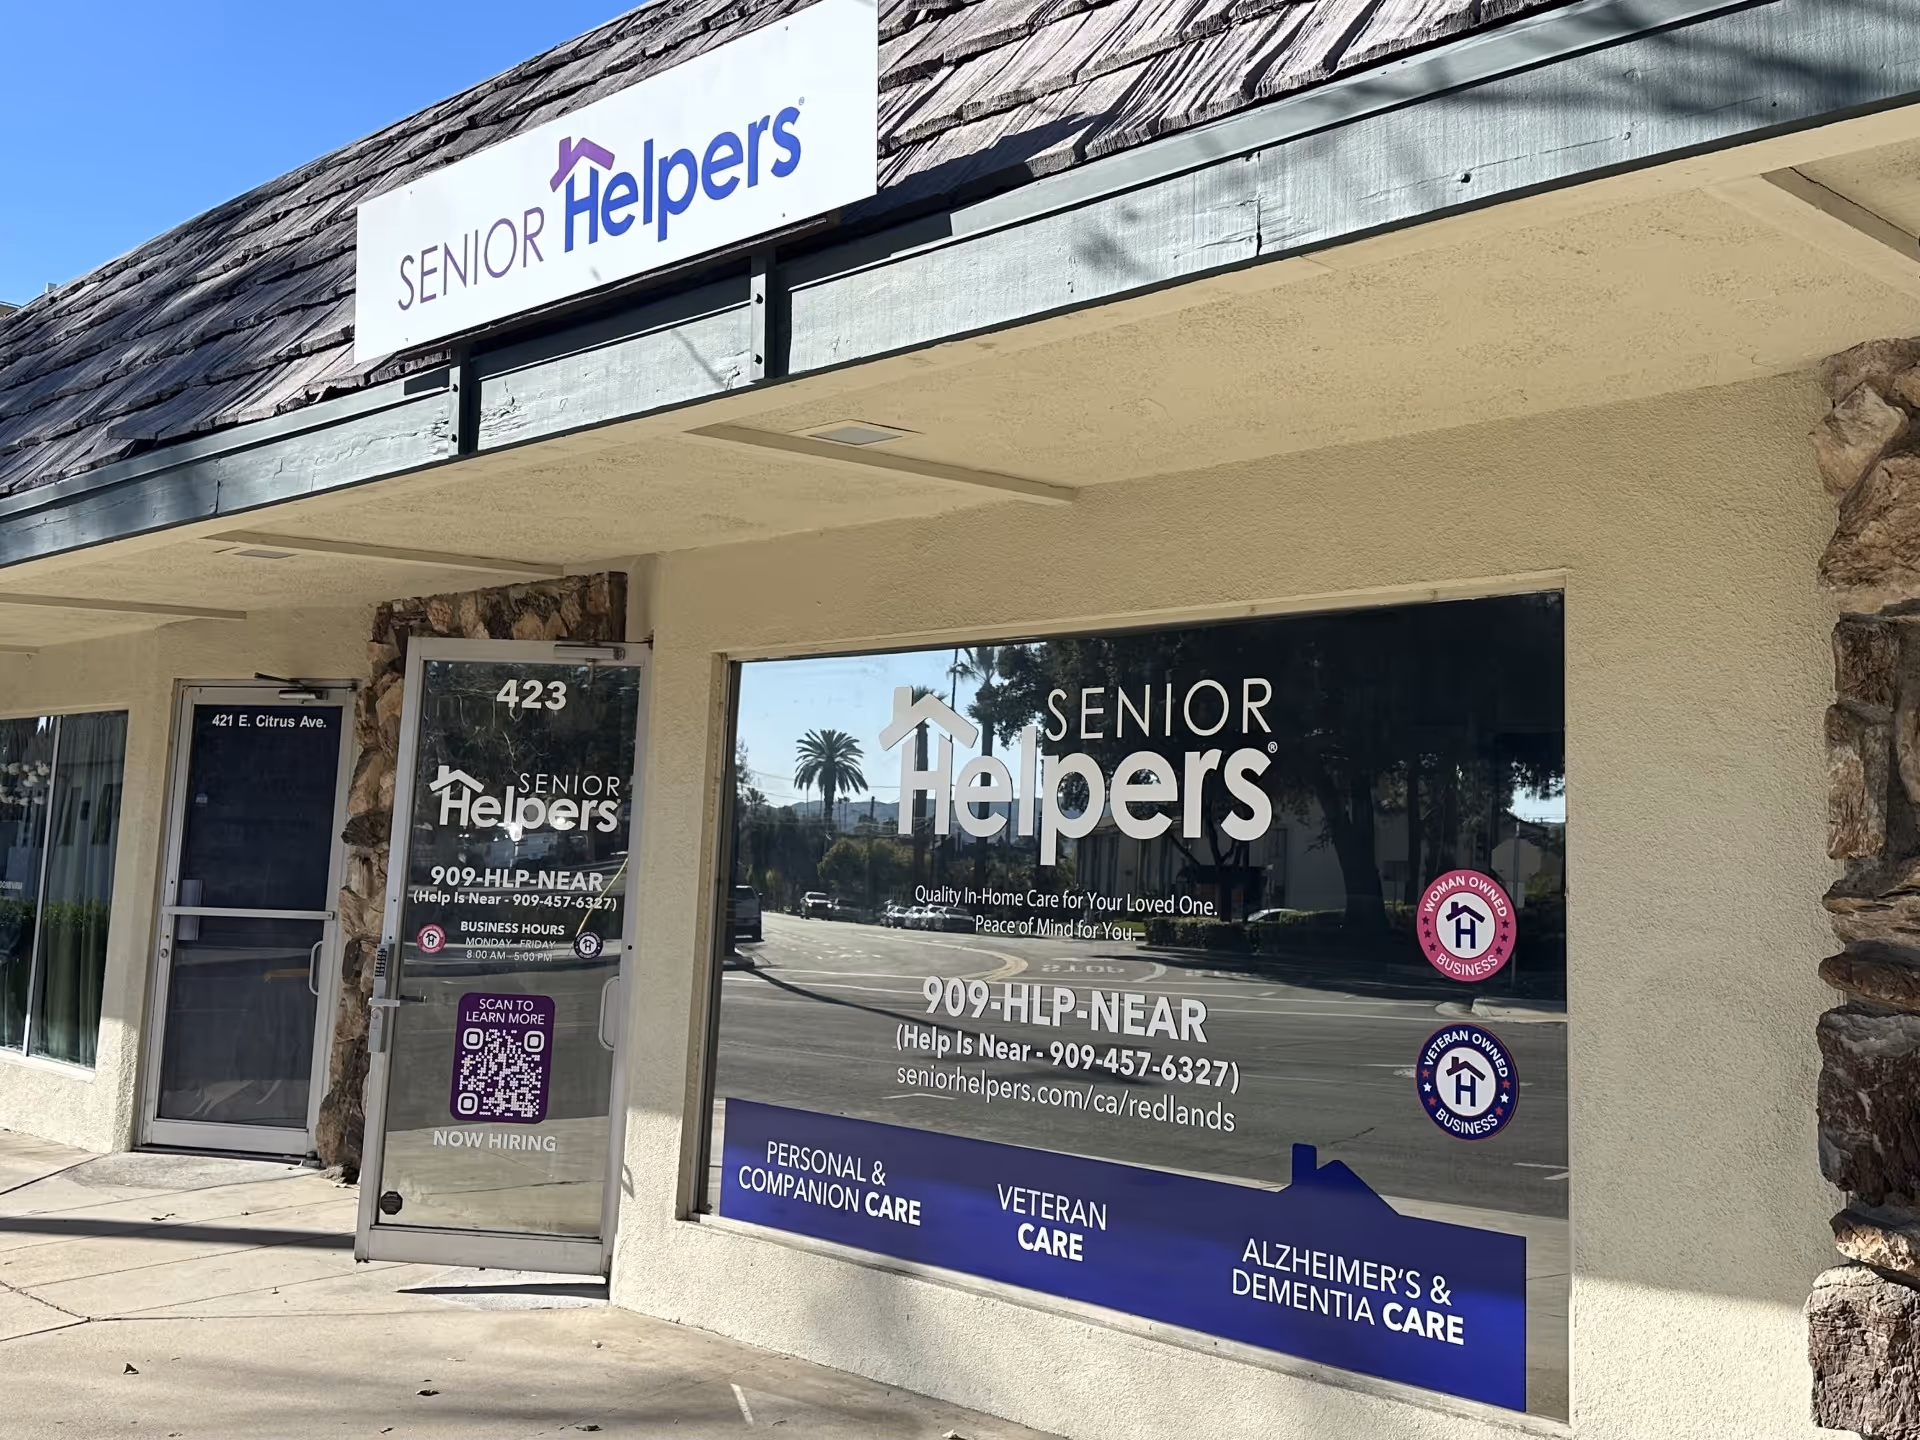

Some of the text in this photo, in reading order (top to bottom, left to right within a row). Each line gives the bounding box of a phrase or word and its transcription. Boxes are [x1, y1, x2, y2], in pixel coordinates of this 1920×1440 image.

[398, 206, 545, 311] SENIOR
[496, 679, 567, 711] 423
[1045, 677, 1272, 742] SENIOR
[212, 714, 327, 728] 421 E. Citrus Ave.
[518, 773, 620, 797] SENIOR
[430, 865, 604, 892] 909-HLP-NEAR
[413, 890, 450, 906] (Help
[454, 892, 466, 904] Is
[469, 892, 501, 905] Near
[512, 893, 618, 912] 909-457-6327)
[914, 885, 1218, 916] Quality In-Home Care for Your Loved One.
[1424, 875, 1508, 918] WOMAN OWNED
[460, 921, 565, 935] BUSINESS HOURS
[465, 937, 512, 948] MONDAY
[520, 939, 556, 950] FRIDAY
[975, 915, 1137, 942] Peace of Mind for You.
[490, 951, 506, 960] AM
[537, 953, 553, 962] PM
[1435, 952, 1499, 976] BUSINESS
[465, 1011, 545, 1025] LEARN MORE
[478, 998, 534, 1012] SCAN TO
[922, 975, 1208, 1043] 909-HLP-NEAR
[896, 1023, 951, 1059] (Help
[957, 1030, 974, 1056] Is
[978, 1033, 1031, 1062] Near
[1049, 1040, 1241, 1095] 909-457-6327)
[1423, 1030, 1509, 1079] VETERAN OWNED
[896, 1063, 1236, 1132] seniorhelpers.com/ca/redlands
[1435, 1107, 1498, 1135] BUSINESS
[433, 1130, 557, 1152] NOW HIRING
[766, 1140, 887, 1187] PERSONAL &
[738, 1165, 922, 1227] COMPANION CARE
[997, 1183, 1107, 1231] VETERAN
[1017, 1223, 1084, 1262] CARE
[1242, 1237, 1453, 1307] ALZHEIMER'S &
[1232, 1268, 1465, 1346] DEMENTIA CARE
